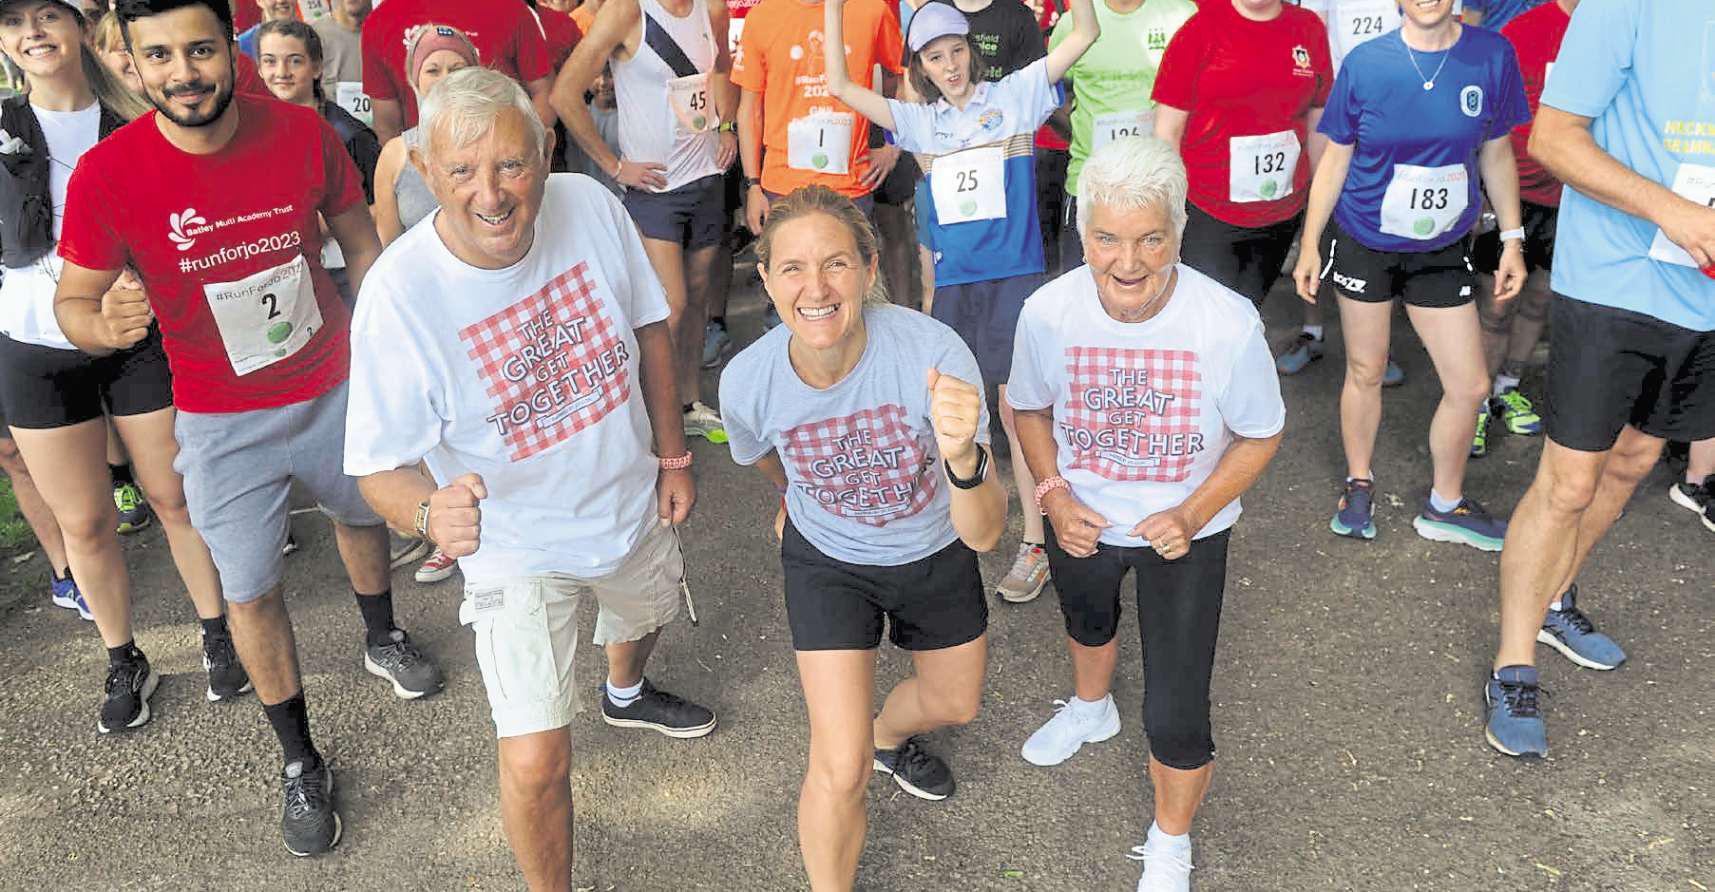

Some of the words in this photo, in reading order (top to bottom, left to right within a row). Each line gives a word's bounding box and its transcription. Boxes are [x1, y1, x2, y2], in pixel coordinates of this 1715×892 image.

[1352, 16, 1383, 35] 224
[353, 97, 371, 113] 20
[690, 90, 706, 111] 45
[1255, 151, 1286, 176] 132
[956, 169, 979, 193] 25
[1410, 187, 1449, 210] 183
[186, 224, 214, 237] Batley
[237, 210, 272, 223] Academy
[272, 204, 294, 215] Trust
[179, 231, 301, 273] #runforjo2023
[261, 293, 281, 320] 2
[519, 309, 554, 341] THE
[503, 316, 588, 383] GREAT
[536, 351, 571, 382] GET
[1110, 368, 1148, 385] THE
[487, 340, 630, 436] TOGETHER
[1084, 386, 1175, 416] GREAT
[1108, 410, 1146, 428] GET
[833, 429, 872, 450] THE
[1060, 421, 1205, 456] TOGETHER
[810, 446, 905, 478] GREAT
[845, 470, 881, 486] GET
[793, 476, 919, 508] TOGETH
